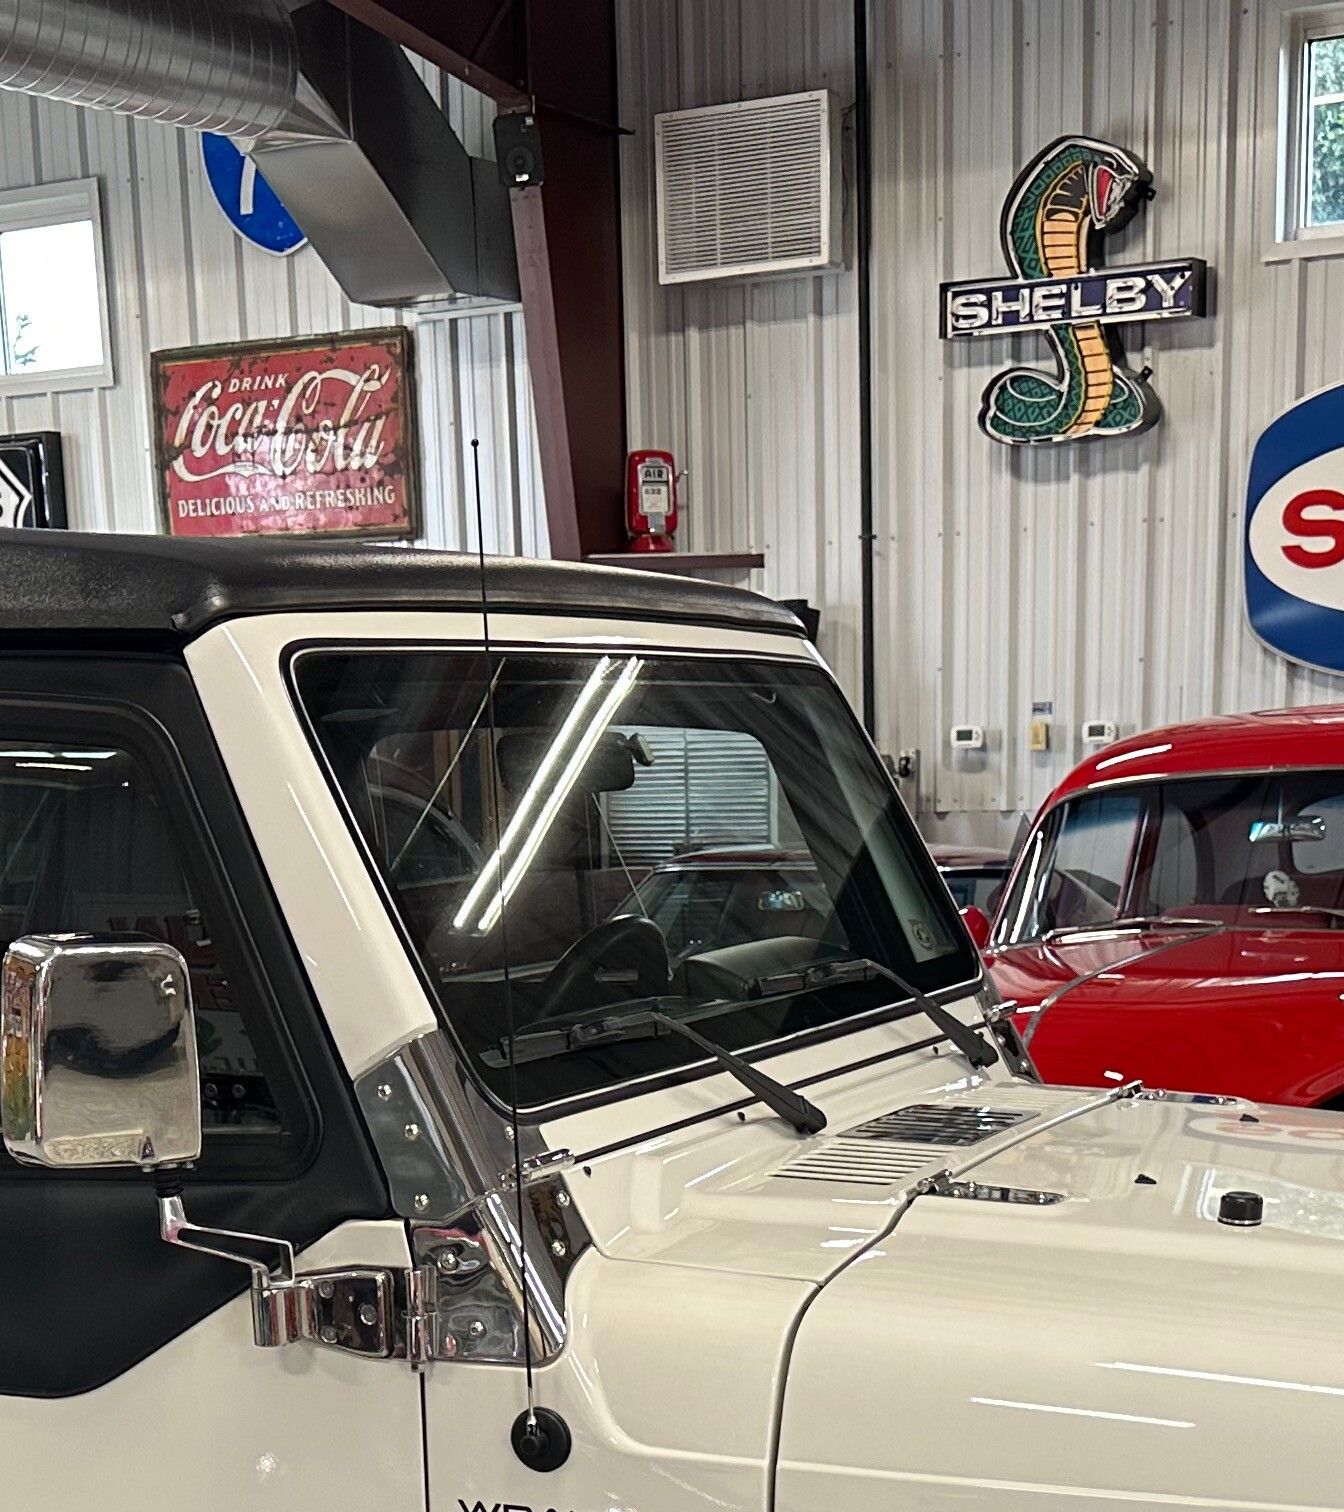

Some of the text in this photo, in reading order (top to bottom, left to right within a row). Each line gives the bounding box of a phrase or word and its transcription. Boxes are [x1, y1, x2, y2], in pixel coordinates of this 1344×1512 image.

[951, 270, 1192, 329] SHELBY
[228, 373, 289, 393] DRINK
[644, 469, 664, 479] AIR
[177, 485, 396, 518] DELICIOUS AND REFRESHING
